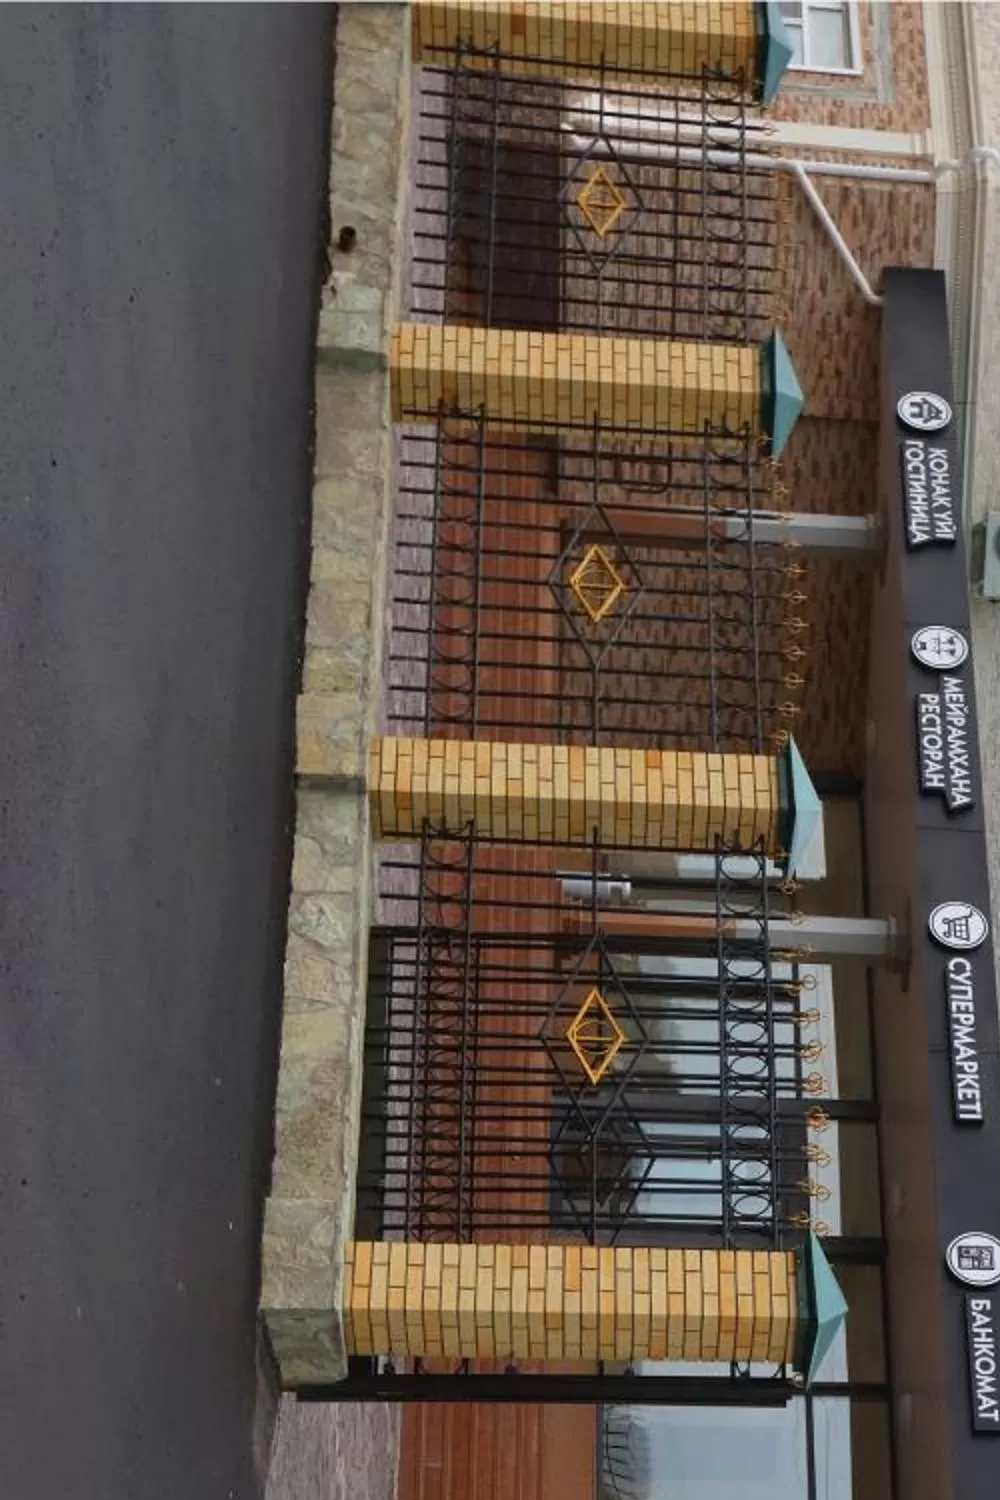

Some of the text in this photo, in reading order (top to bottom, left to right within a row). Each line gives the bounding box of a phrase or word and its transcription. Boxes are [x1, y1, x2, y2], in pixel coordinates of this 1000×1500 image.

[905, 440, 931, 544] ГОСТИНИЦА
[919, 693, 946, 788] РЕСТОРАН
[943, 676, 972, 807] МЕЙРАМХАНА
[948, 957, 983, 1120] СУПЕРМАРКЕТІ
[970, 1299, 999, 1422] БАНКОМАТ
